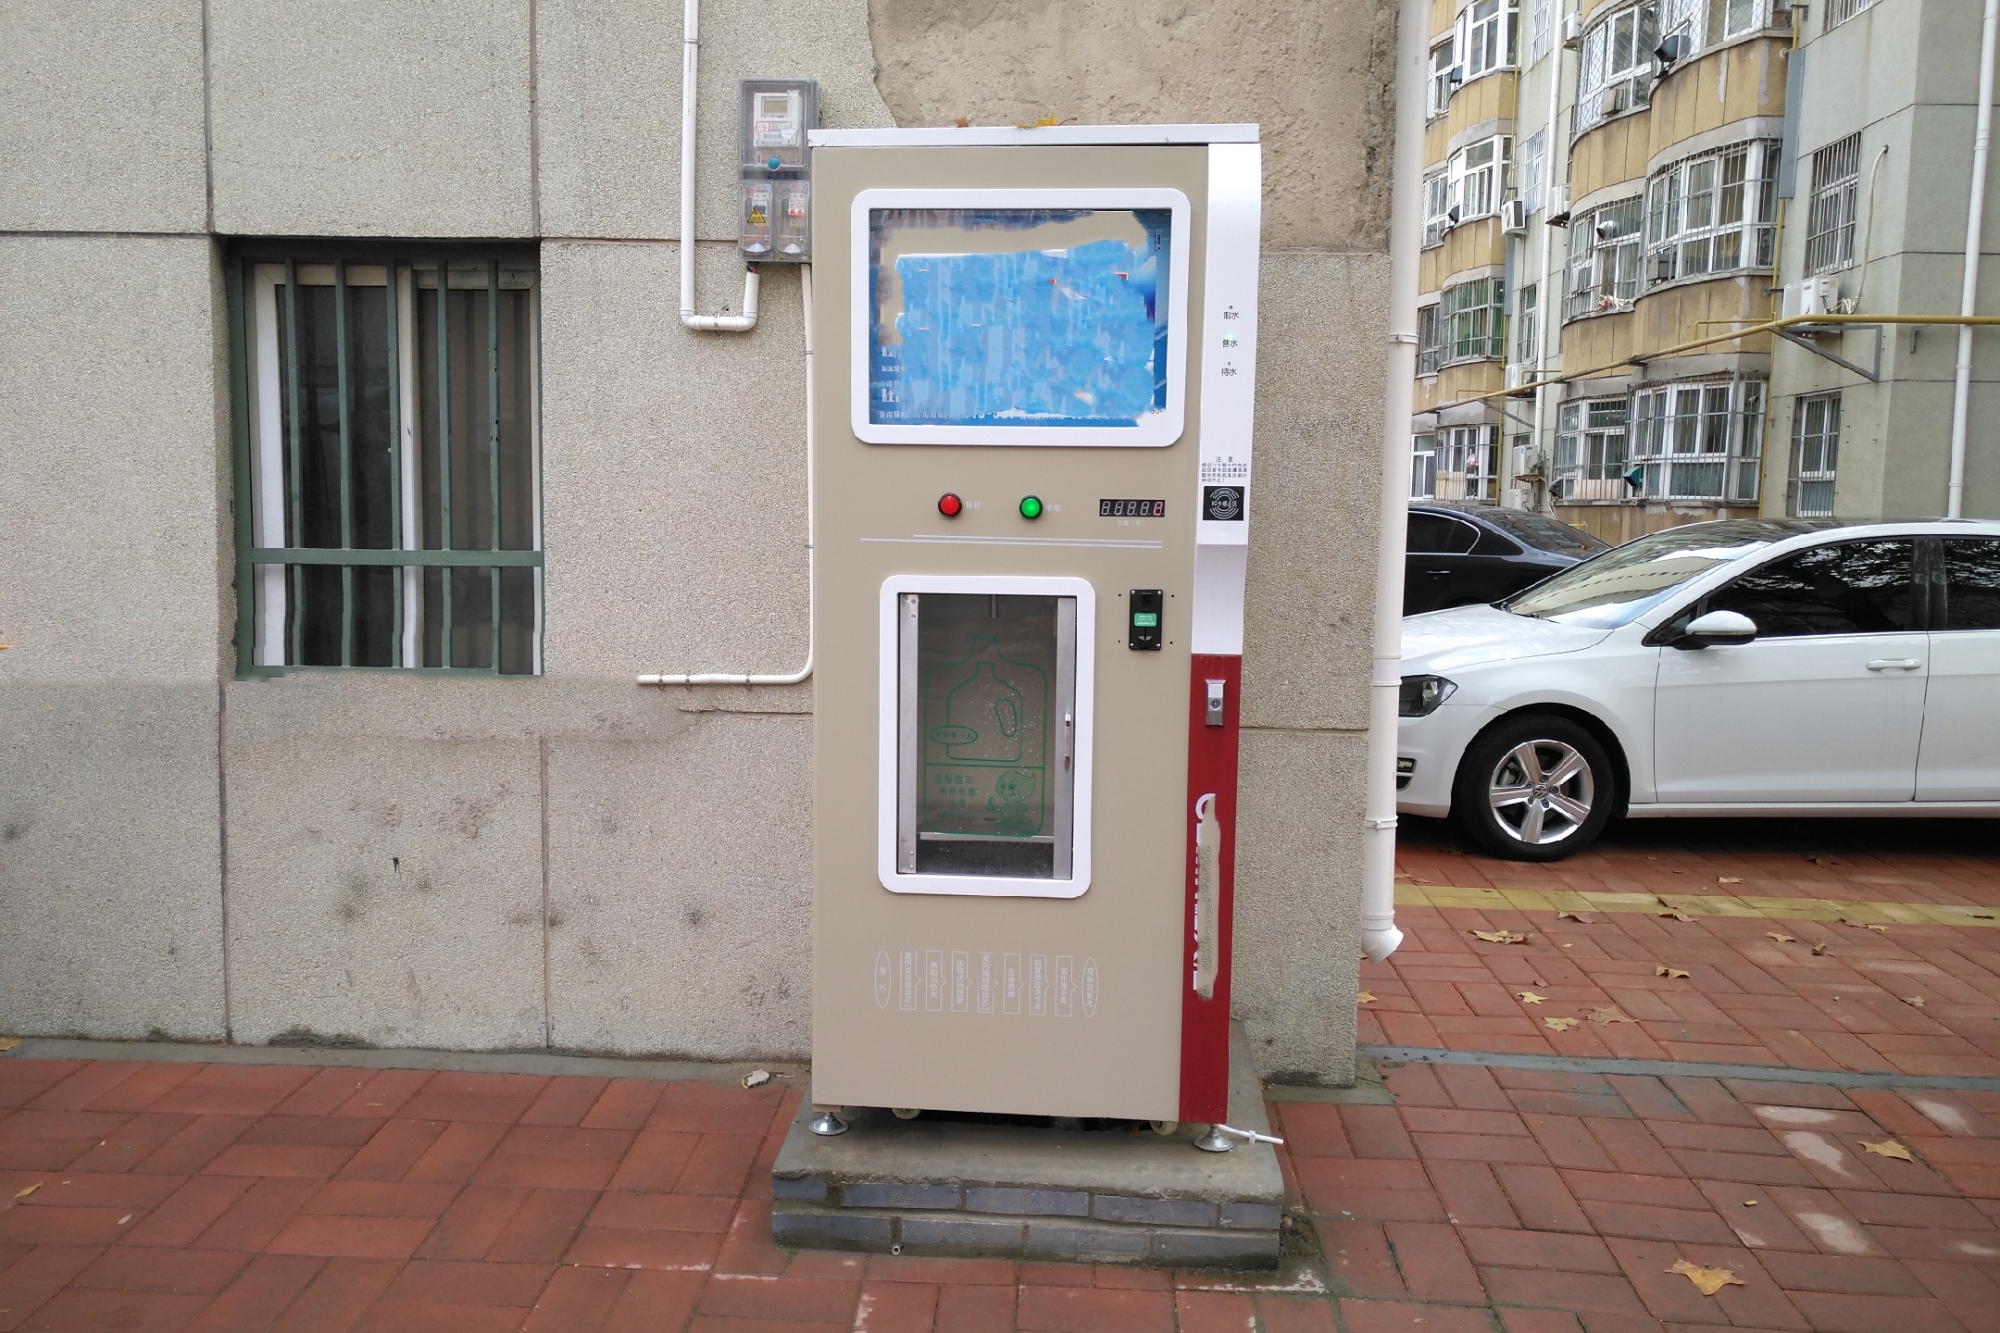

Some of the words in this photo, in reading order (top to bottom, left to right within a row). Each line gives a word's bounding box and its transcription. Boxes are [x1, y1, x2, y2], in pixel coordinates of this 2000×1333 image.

[1223, 311, 1240, 320] 制水
[1222, 339, 1238, 348] 售水
[1221, 368, 1237, 377] 待水
[965, 501, 982, 509] 暂停
[934, 773, 973, 784] 温馨提示
